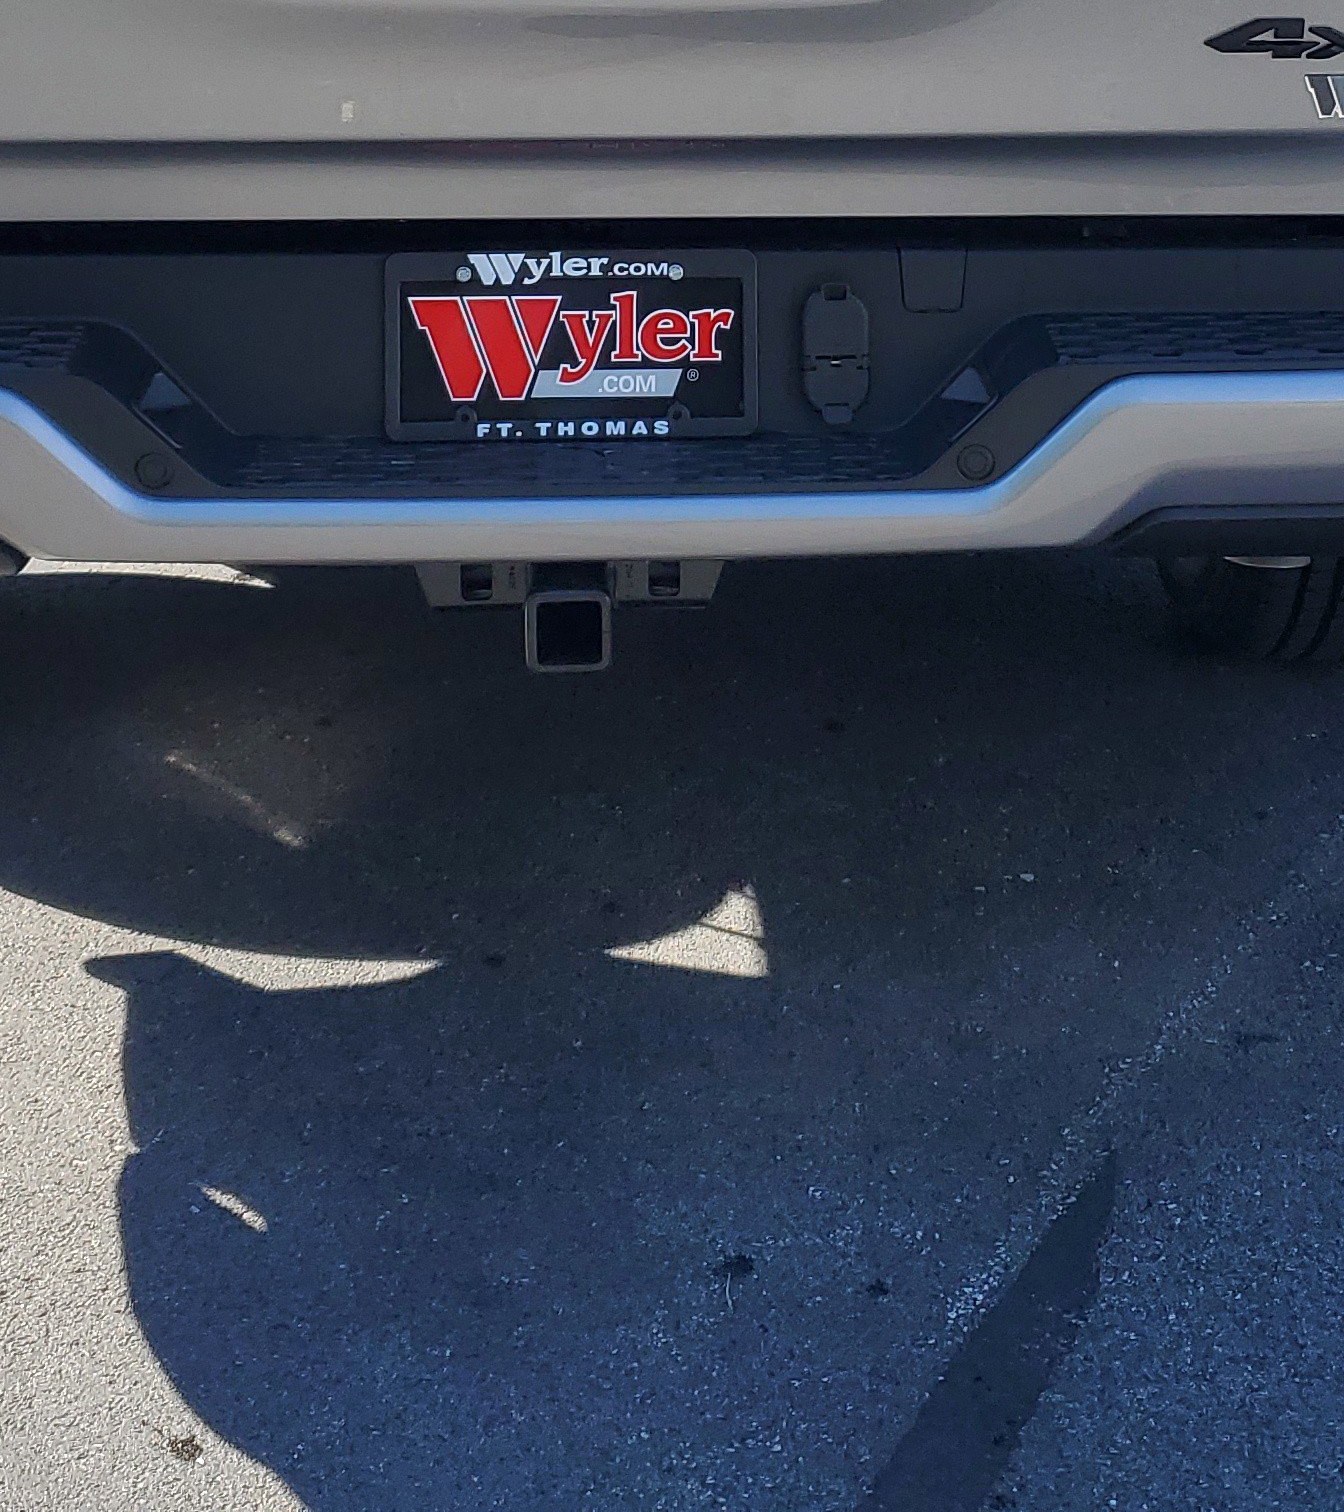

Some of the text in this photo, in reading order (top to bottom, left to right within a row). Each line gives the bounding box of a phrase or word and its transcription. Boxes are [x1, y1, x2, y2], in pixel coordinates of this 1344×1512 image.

[407, 291, 735, 402] Wyler
[476, 419, 670, 438] FT. THOMAS
